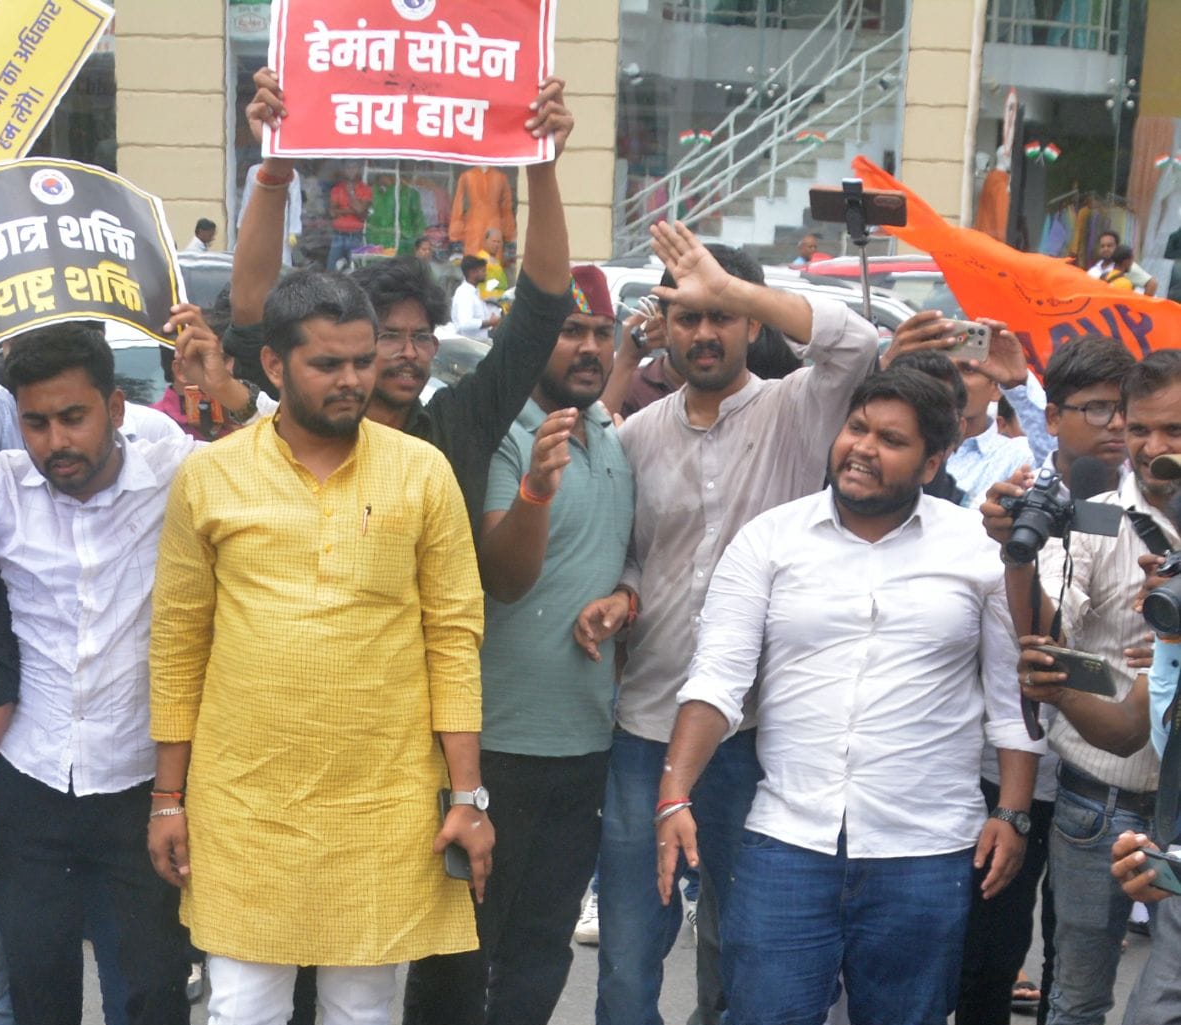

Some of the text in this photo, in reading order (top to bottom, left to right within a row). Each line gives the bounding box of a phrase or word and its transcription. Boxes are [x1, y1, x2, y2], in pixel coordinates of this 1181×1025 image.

[14, 0, 63, 64] अधिकार
[304, 18, 520, 82] हेमंत सोरेन
[330, 93, 490, 141] हाय हाय
[57, 209, 136, 261] शक्ति
[64, 260, 142, 312] शक्ति
